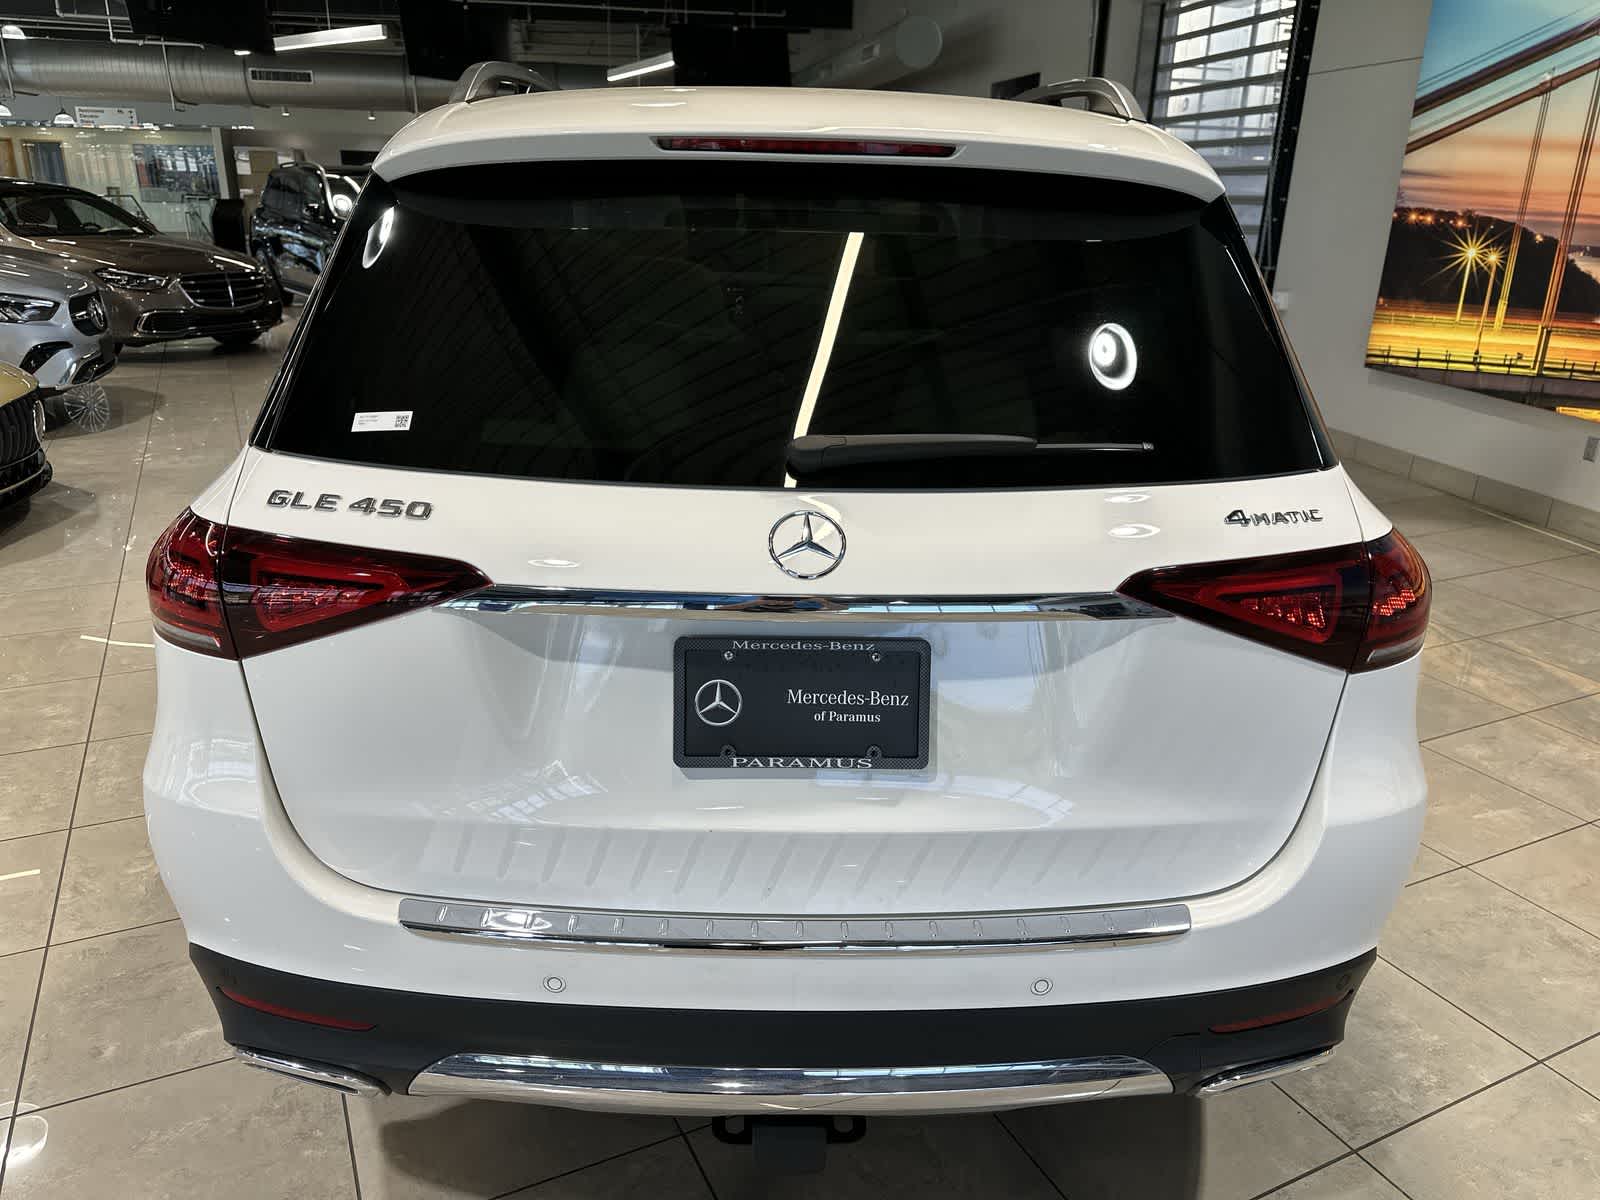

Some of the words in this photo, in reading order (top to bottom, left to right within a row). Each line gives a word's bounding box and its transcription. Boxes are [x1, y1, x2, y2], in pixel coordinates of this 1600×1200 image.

[267, 489, 342, 512] GLE
[349, 497, 433, 520] 450
[1224, 509, 1323, 527] 4MATIC
[732, 640, 876, 651] Mercedes-Benz
[787, 689, 909, 706] Mercedes-Benz
[814, 711, 827, 722] of
[829, 711, 881, 723] Paramus
[732, 757, 873, 769] PARAMUS
